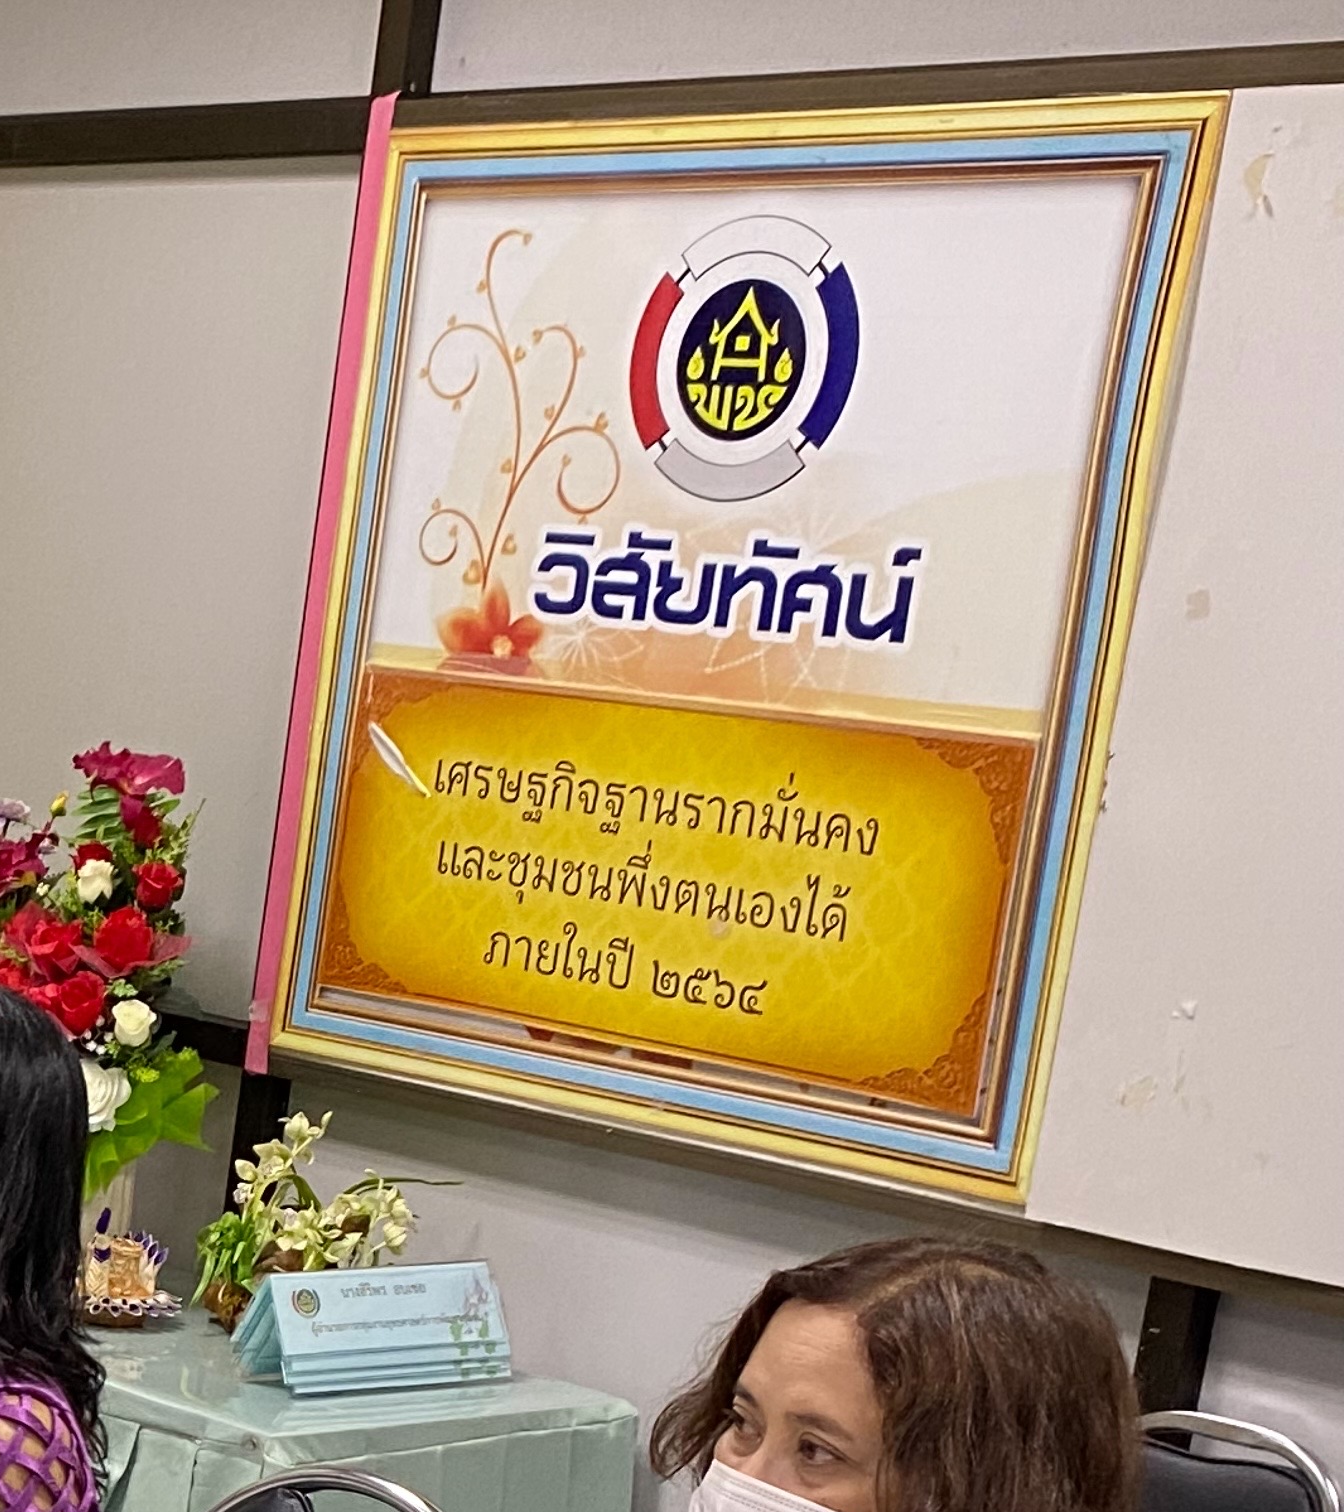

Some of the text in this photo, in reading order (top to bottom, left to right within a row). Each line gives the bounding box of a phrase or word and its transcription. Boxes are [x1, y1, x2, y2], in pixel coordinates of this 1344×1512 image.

[532, 530, 924, 645] วิสัยทัศน์
[432, 758, 881, 857] เศรษฐกิจฐานรากมั่นคง
[435, 838, 853, 943] และชุมชนพึ่งตนเองได้
[482, 920, 769, 1016] ภายในปี ๒๕๖๔
